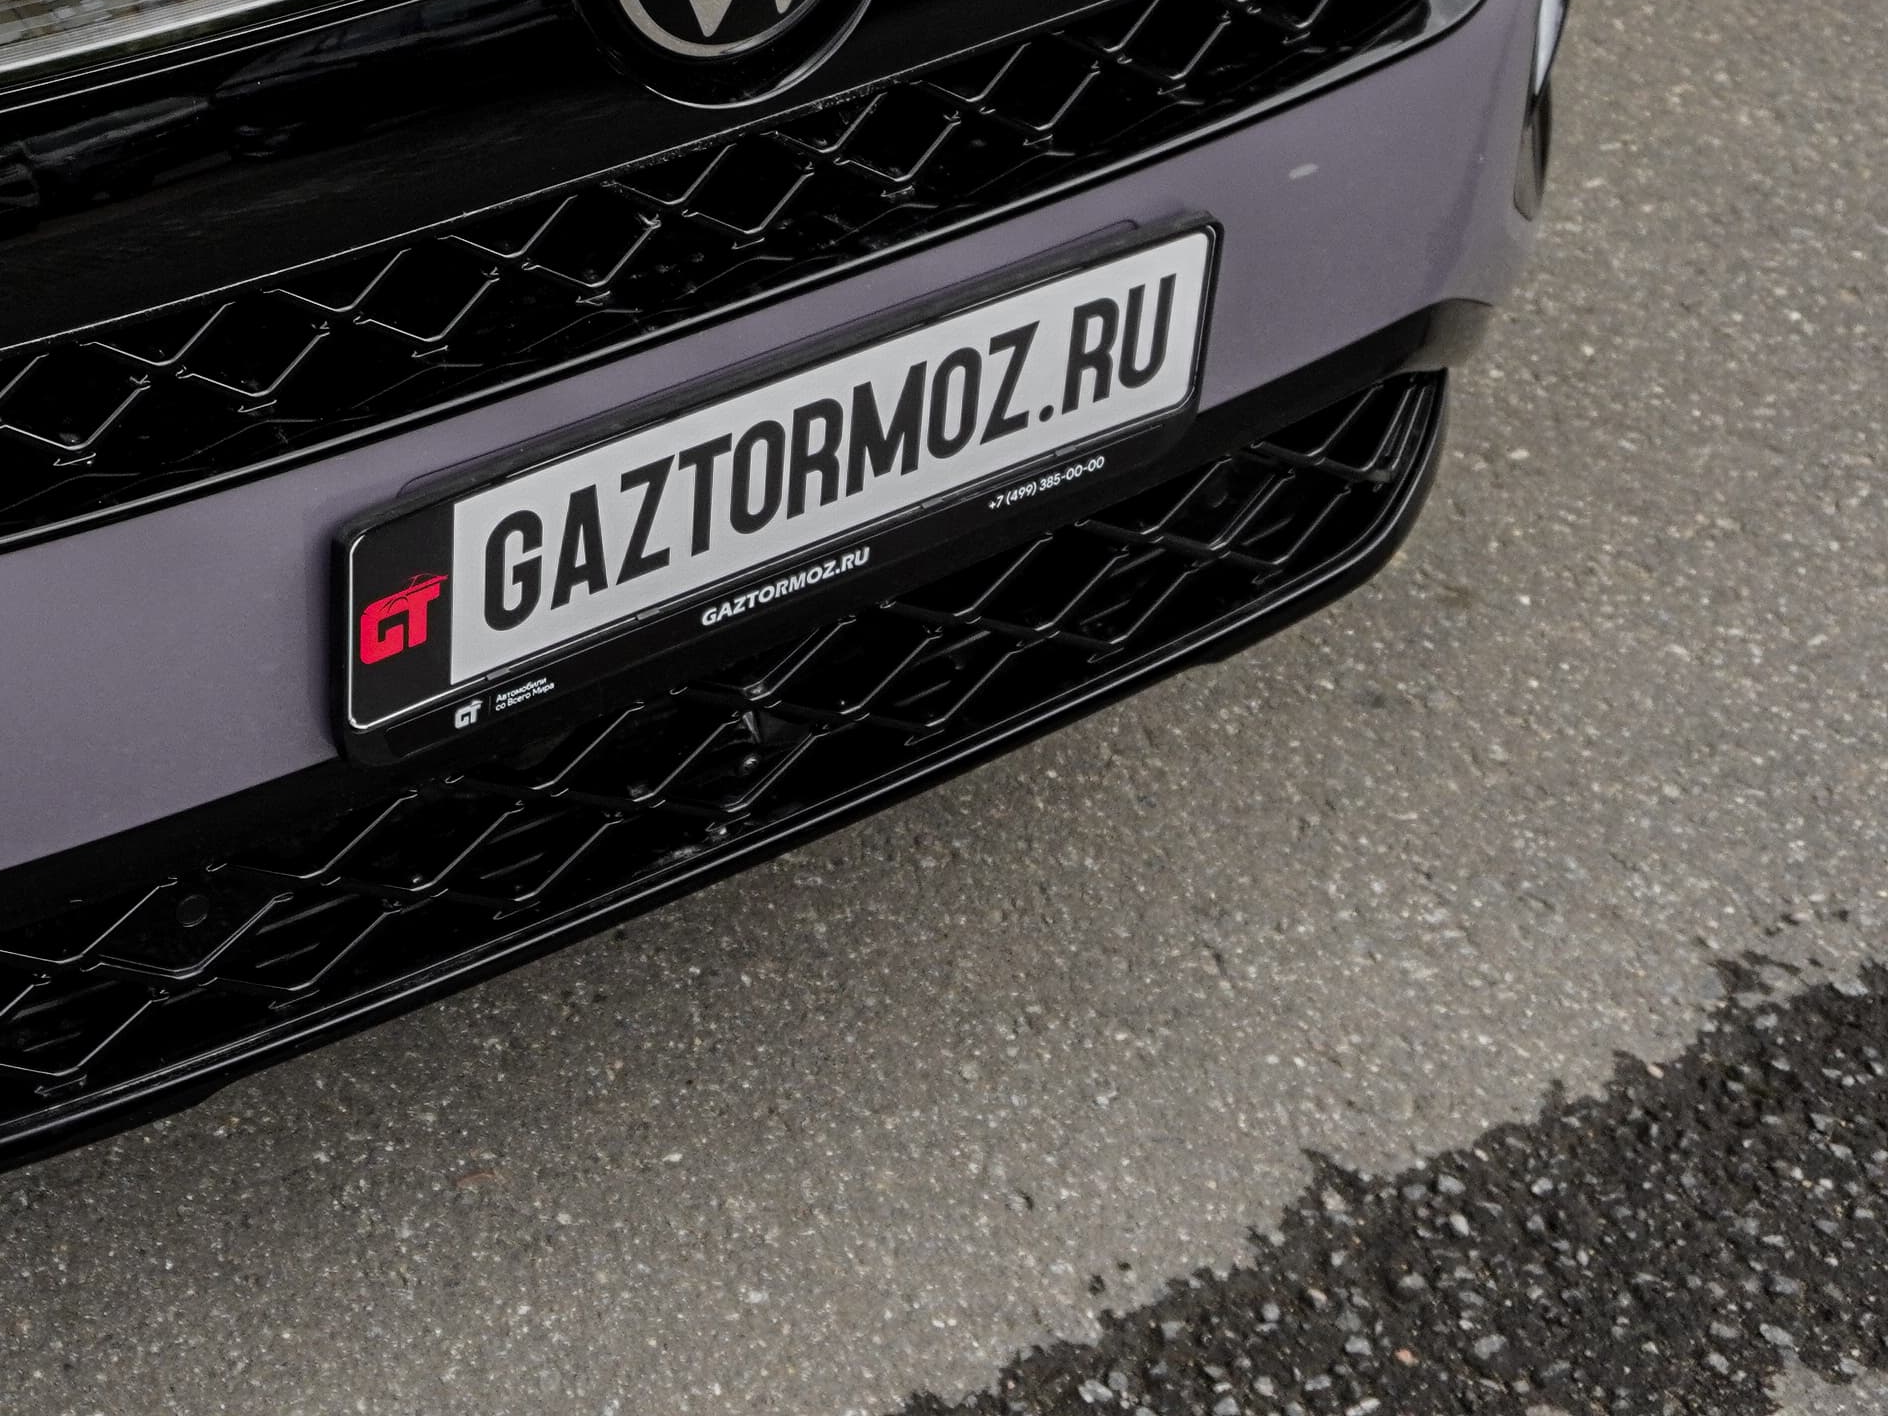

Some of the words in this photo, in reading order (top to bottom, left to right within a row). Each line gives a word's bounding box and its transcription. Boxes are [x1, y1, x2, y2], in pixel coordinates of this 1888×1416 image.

[483, 272, 1178, 632] GAZTORMOZ.RU
[988, 494, 1004, 510] +7
[1005, 481, 1038, 505] (499)
[1039, 456, 1105, 491] 385-00-00
[360, 574, 448, 664] GT
[701, 546, 870, 626] GAZTORMOZ.RU
[454, 699, 483, 729] GT
